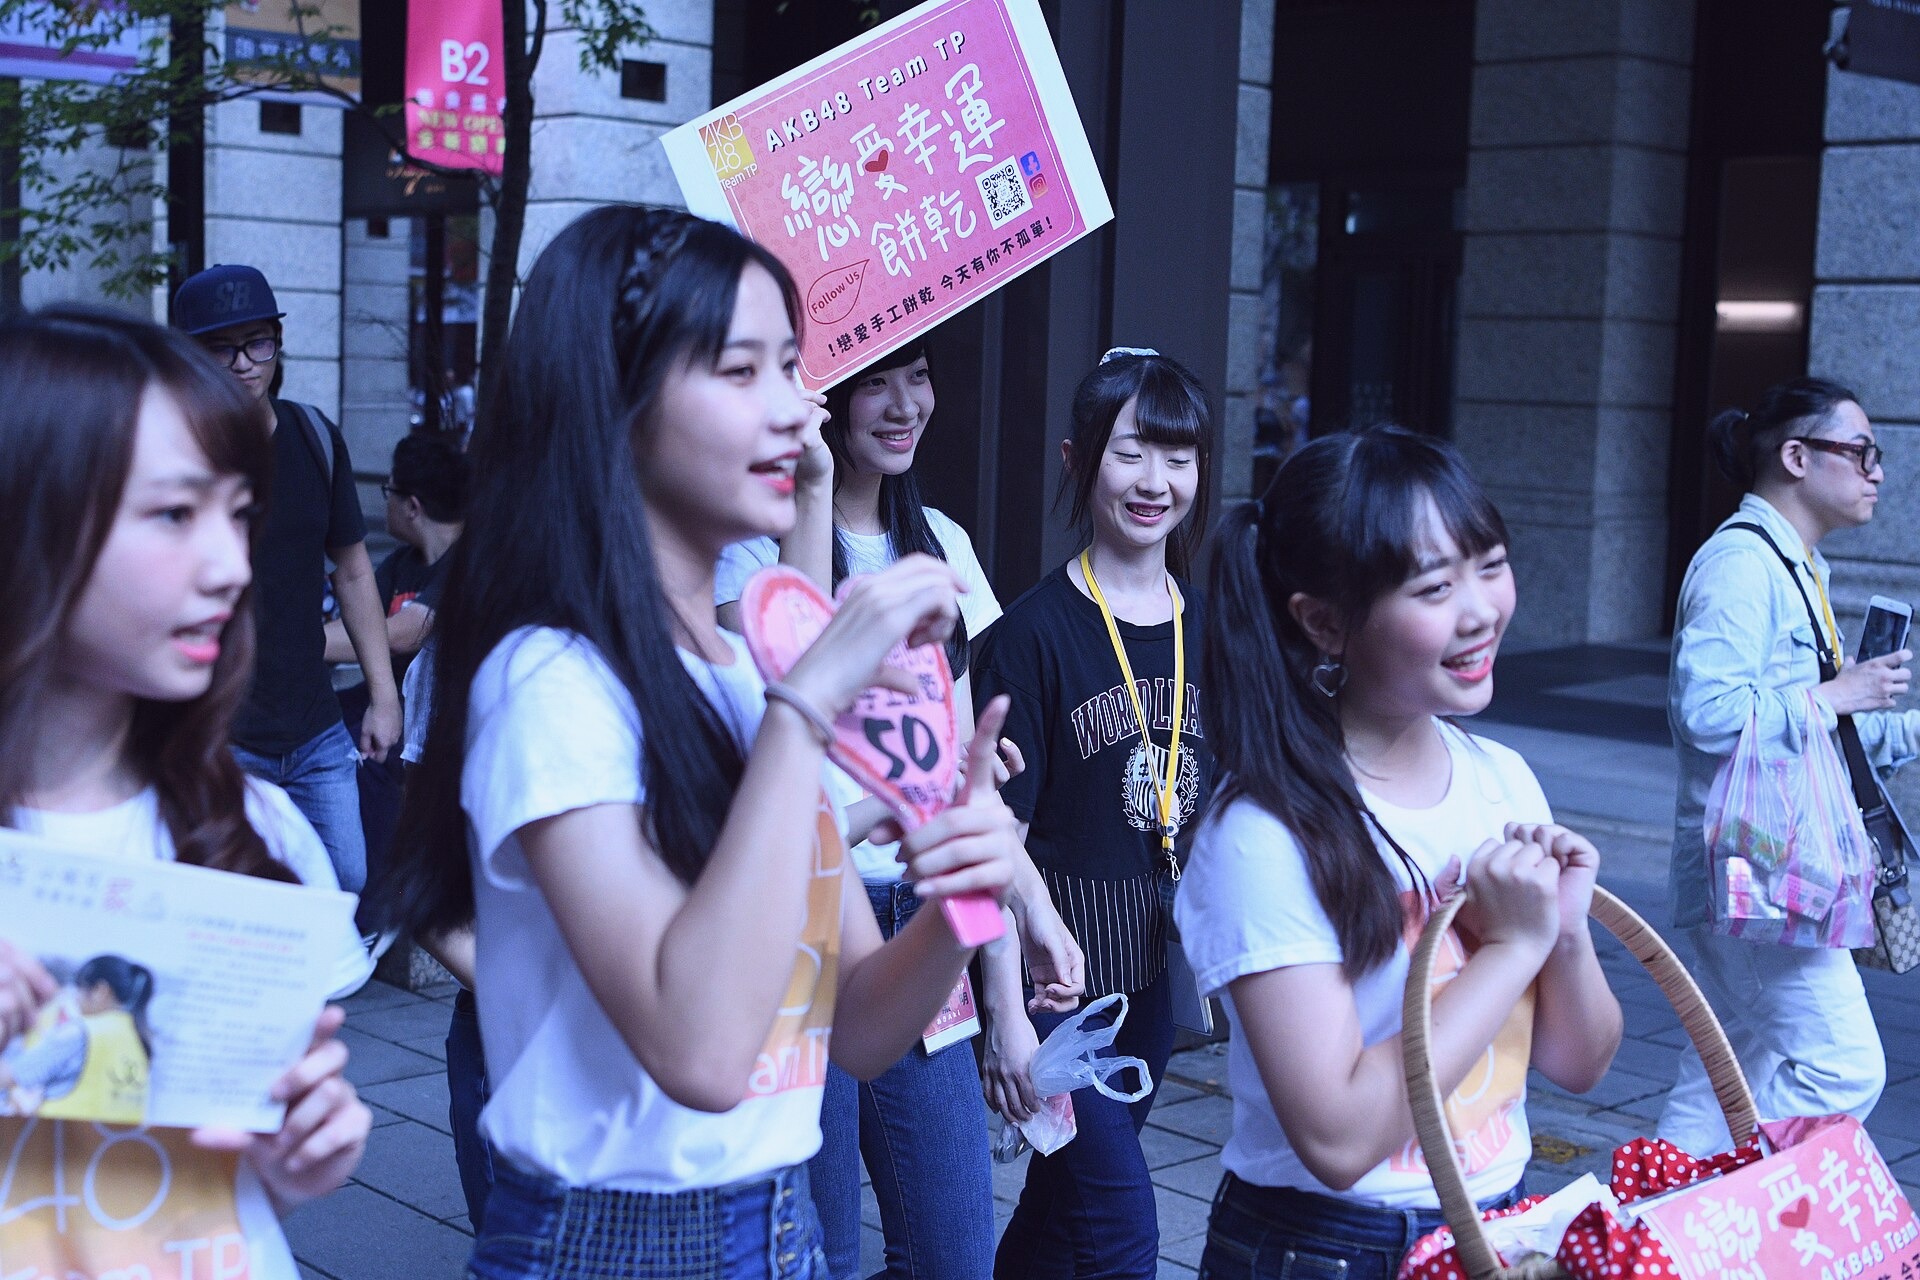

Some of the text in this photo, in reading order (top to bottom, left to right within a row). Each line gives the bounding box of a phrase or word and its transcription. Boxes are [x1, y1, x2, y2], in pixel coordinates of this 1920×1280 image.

[440, 39, 490, 86] B2
[764, 30, 967, 154] AKB48 Team TP
[704, 112, 744, 147] AKB
[713, 142, 741, 173] 48
[720, 163, 758, 191] Team TP
[870, 189, 977, 279] 餅乾
[811, 270, 861, 315] Follow Us
[1821, 1240, 1884, 1280] AKB48
